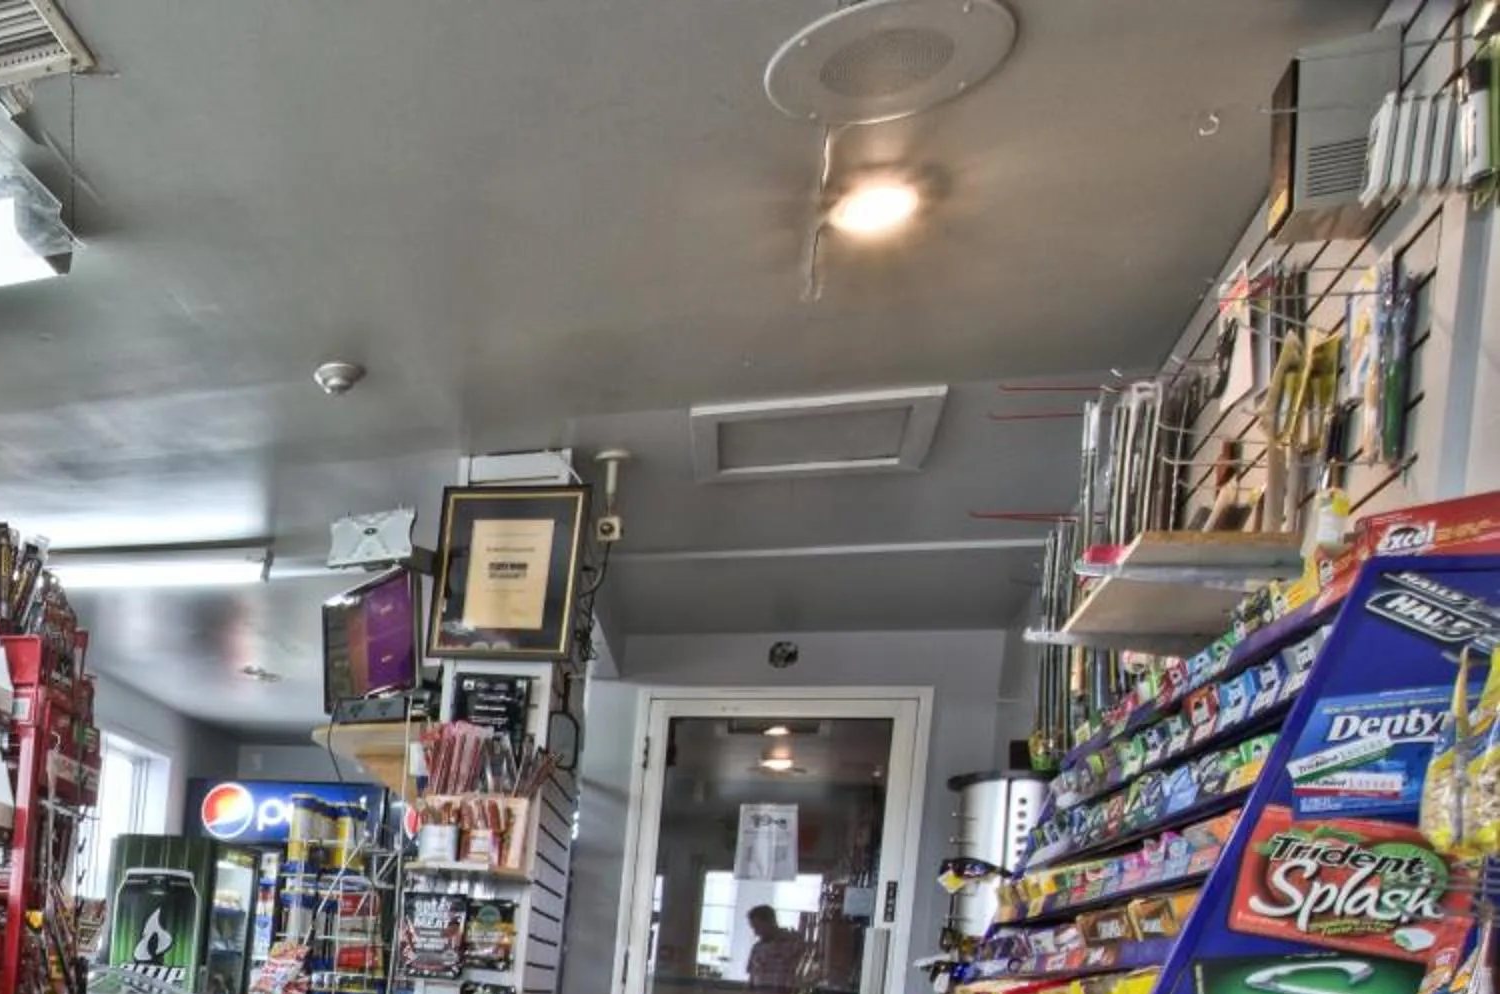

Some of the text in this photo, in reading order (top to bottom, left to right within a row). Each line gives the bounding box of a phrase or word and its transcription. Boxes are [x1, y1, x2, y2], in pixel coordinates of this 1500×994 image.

[1385, 595, 1472, 635] HALLS
[1269, 834, 1423, 875] Trident
[1249, 859, 1444, 932] Splash
